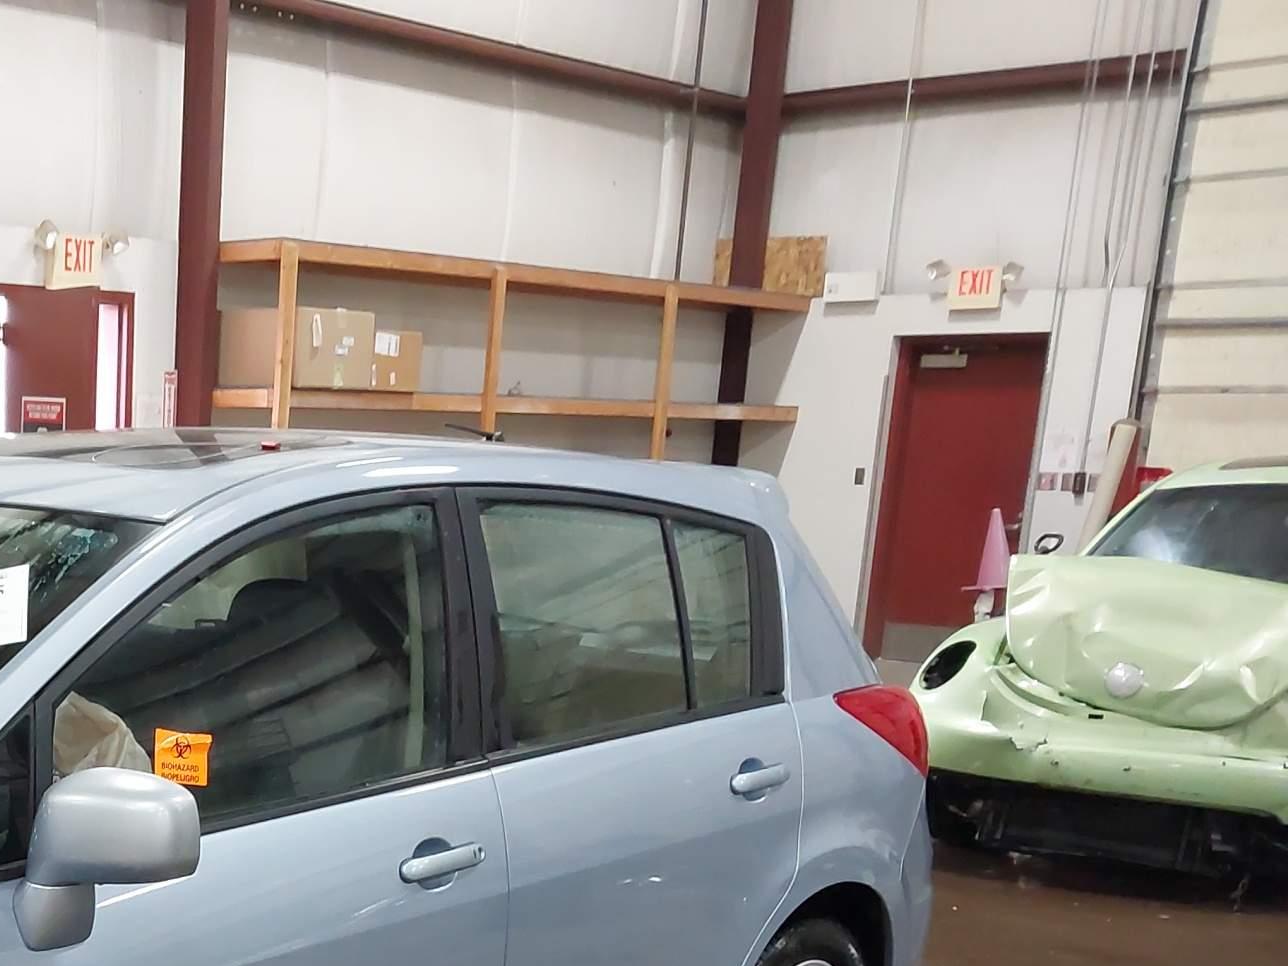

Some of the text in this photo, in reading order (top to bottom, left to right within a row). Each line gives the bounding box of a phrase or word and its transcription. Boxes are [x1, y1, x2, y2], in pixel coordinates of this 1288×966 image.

[64, 238, 95, 272] EXIT
[958, 268, 994, 296] EXIT
[161, 761, 200, 773] BIOHAZARD
